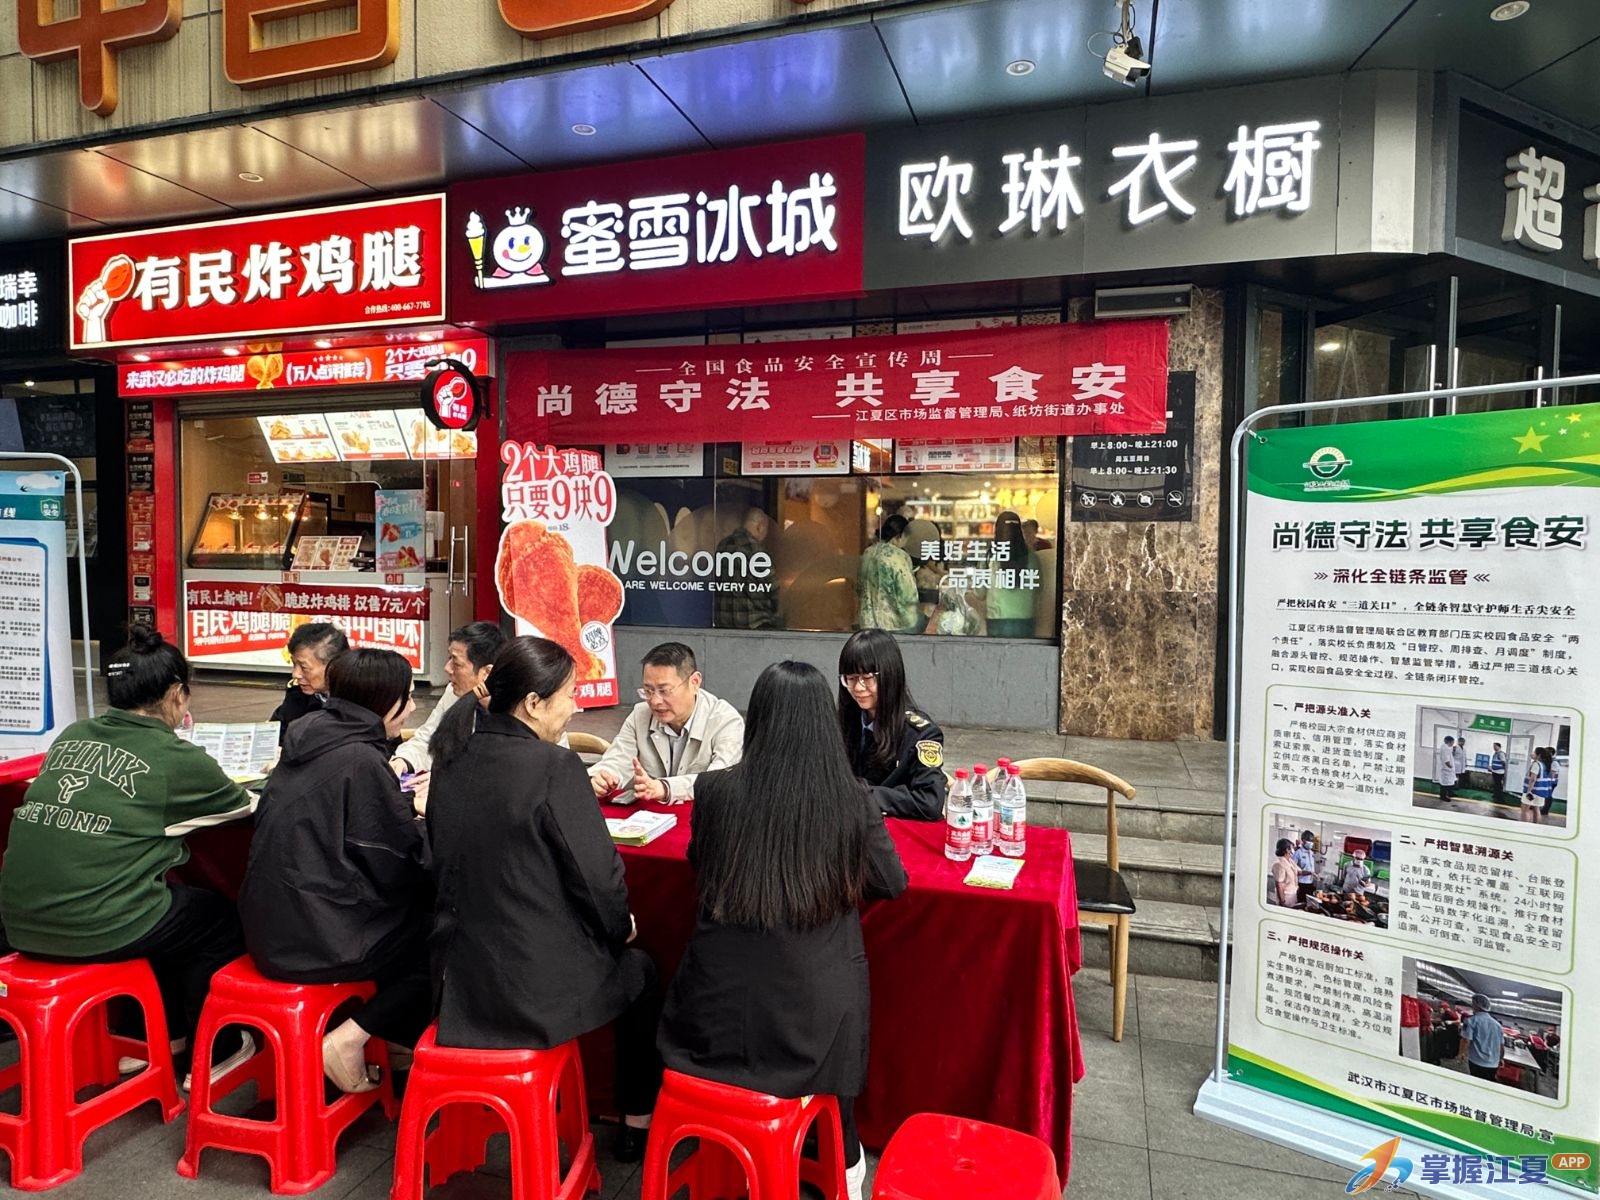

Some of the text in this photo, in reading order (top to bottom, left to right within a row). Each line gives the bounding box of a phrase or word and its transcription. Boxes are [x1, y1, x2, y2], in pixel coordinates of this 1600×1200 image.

[898, 119, 1321, 243] 欧琳衣橱
[560, 171, 838, 277] 蜜雪冰城
[132, 224, 422, 312] 有民炸鸡腿
[126, 363, 246, 389] 来武汉必吃的炸鸡腿
[537, 361, 1126, 417] 尚德守法 共享食安
[503, 442, 600, 484] 2个大鸡腿
[505, 474, 613, 523] 只要9块9
[1272, 515, 1585, 550] 尚德守法 共享食安
[608, 540, 772, 578] Welcome
[920, 540, 1011, 562] 美好生活
[624, 580, 772, 593] ARE WELCOME EVERY DAY
[948, 568, 1040, 590] 品质相伴
[1332, 568, 1468, 585] 深化全链条监管
[284, 591, 350, 612] 脆皮炸鸡排
[17, 801, 112, 834] BEYOND
[1347, 1071, 1555, 1145] 武汉市江夏区市场监督管理局 宣
